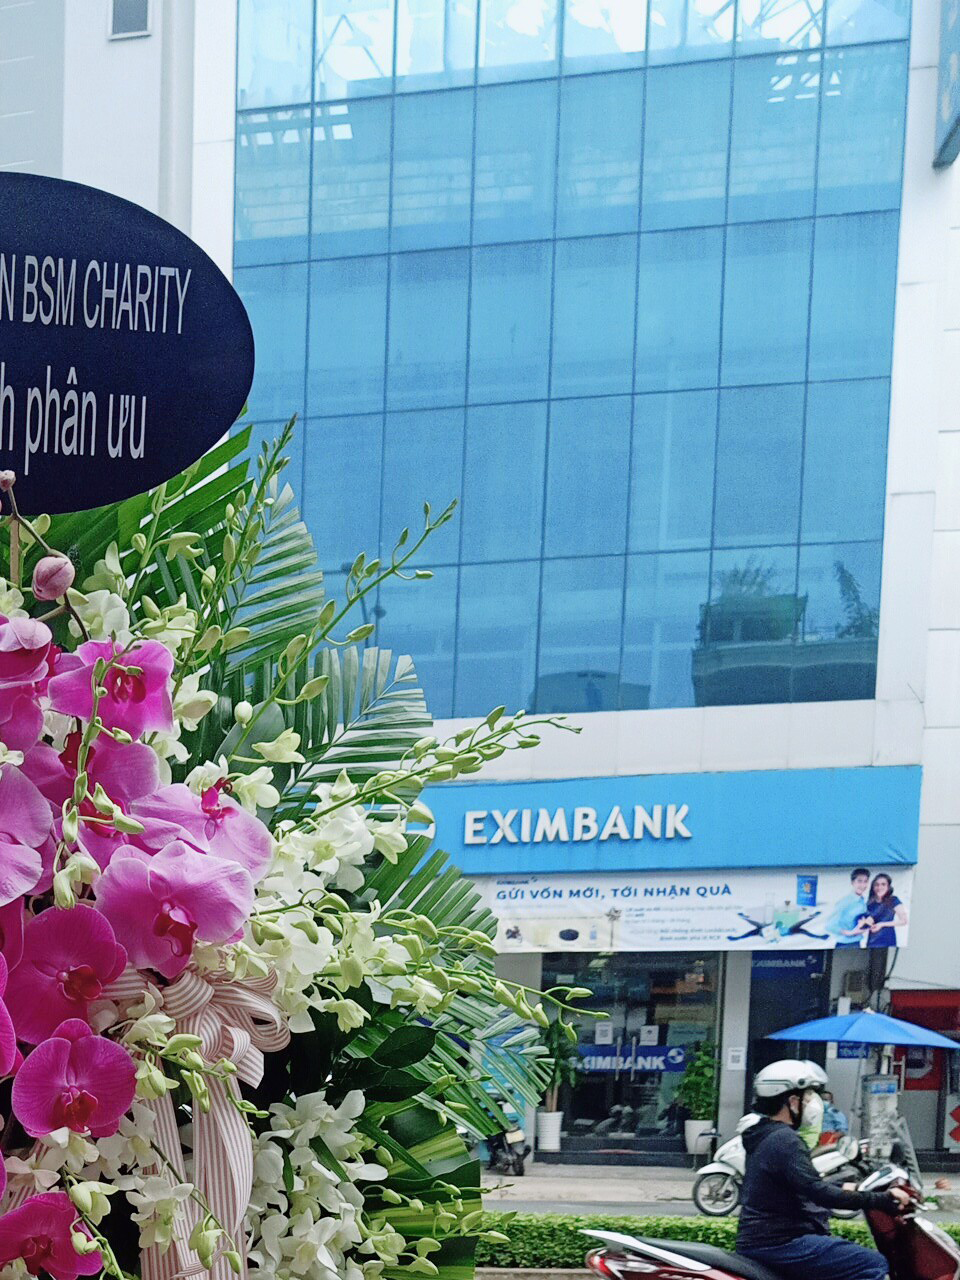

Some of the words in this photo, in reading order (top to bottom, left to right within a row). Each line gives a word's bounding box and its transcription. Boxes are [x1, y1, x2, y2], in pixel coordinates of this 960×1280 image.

[22, 255, 78, 326] BSM
[82, 259, 192, 335] CHARITY
[24, 364, 96, 476] phân
[107, 393, 147, 459] ưu
[463, 803, 693, 845] EXIMBANK
[530, 886, 563, 899] VỐN
[569, 886, 605, 900] MỚI,
[611, 885, 637, 898] TỚI
[643, 885, 690, 899] NHẬN
[696, 883, 732, 897] QUÀ
